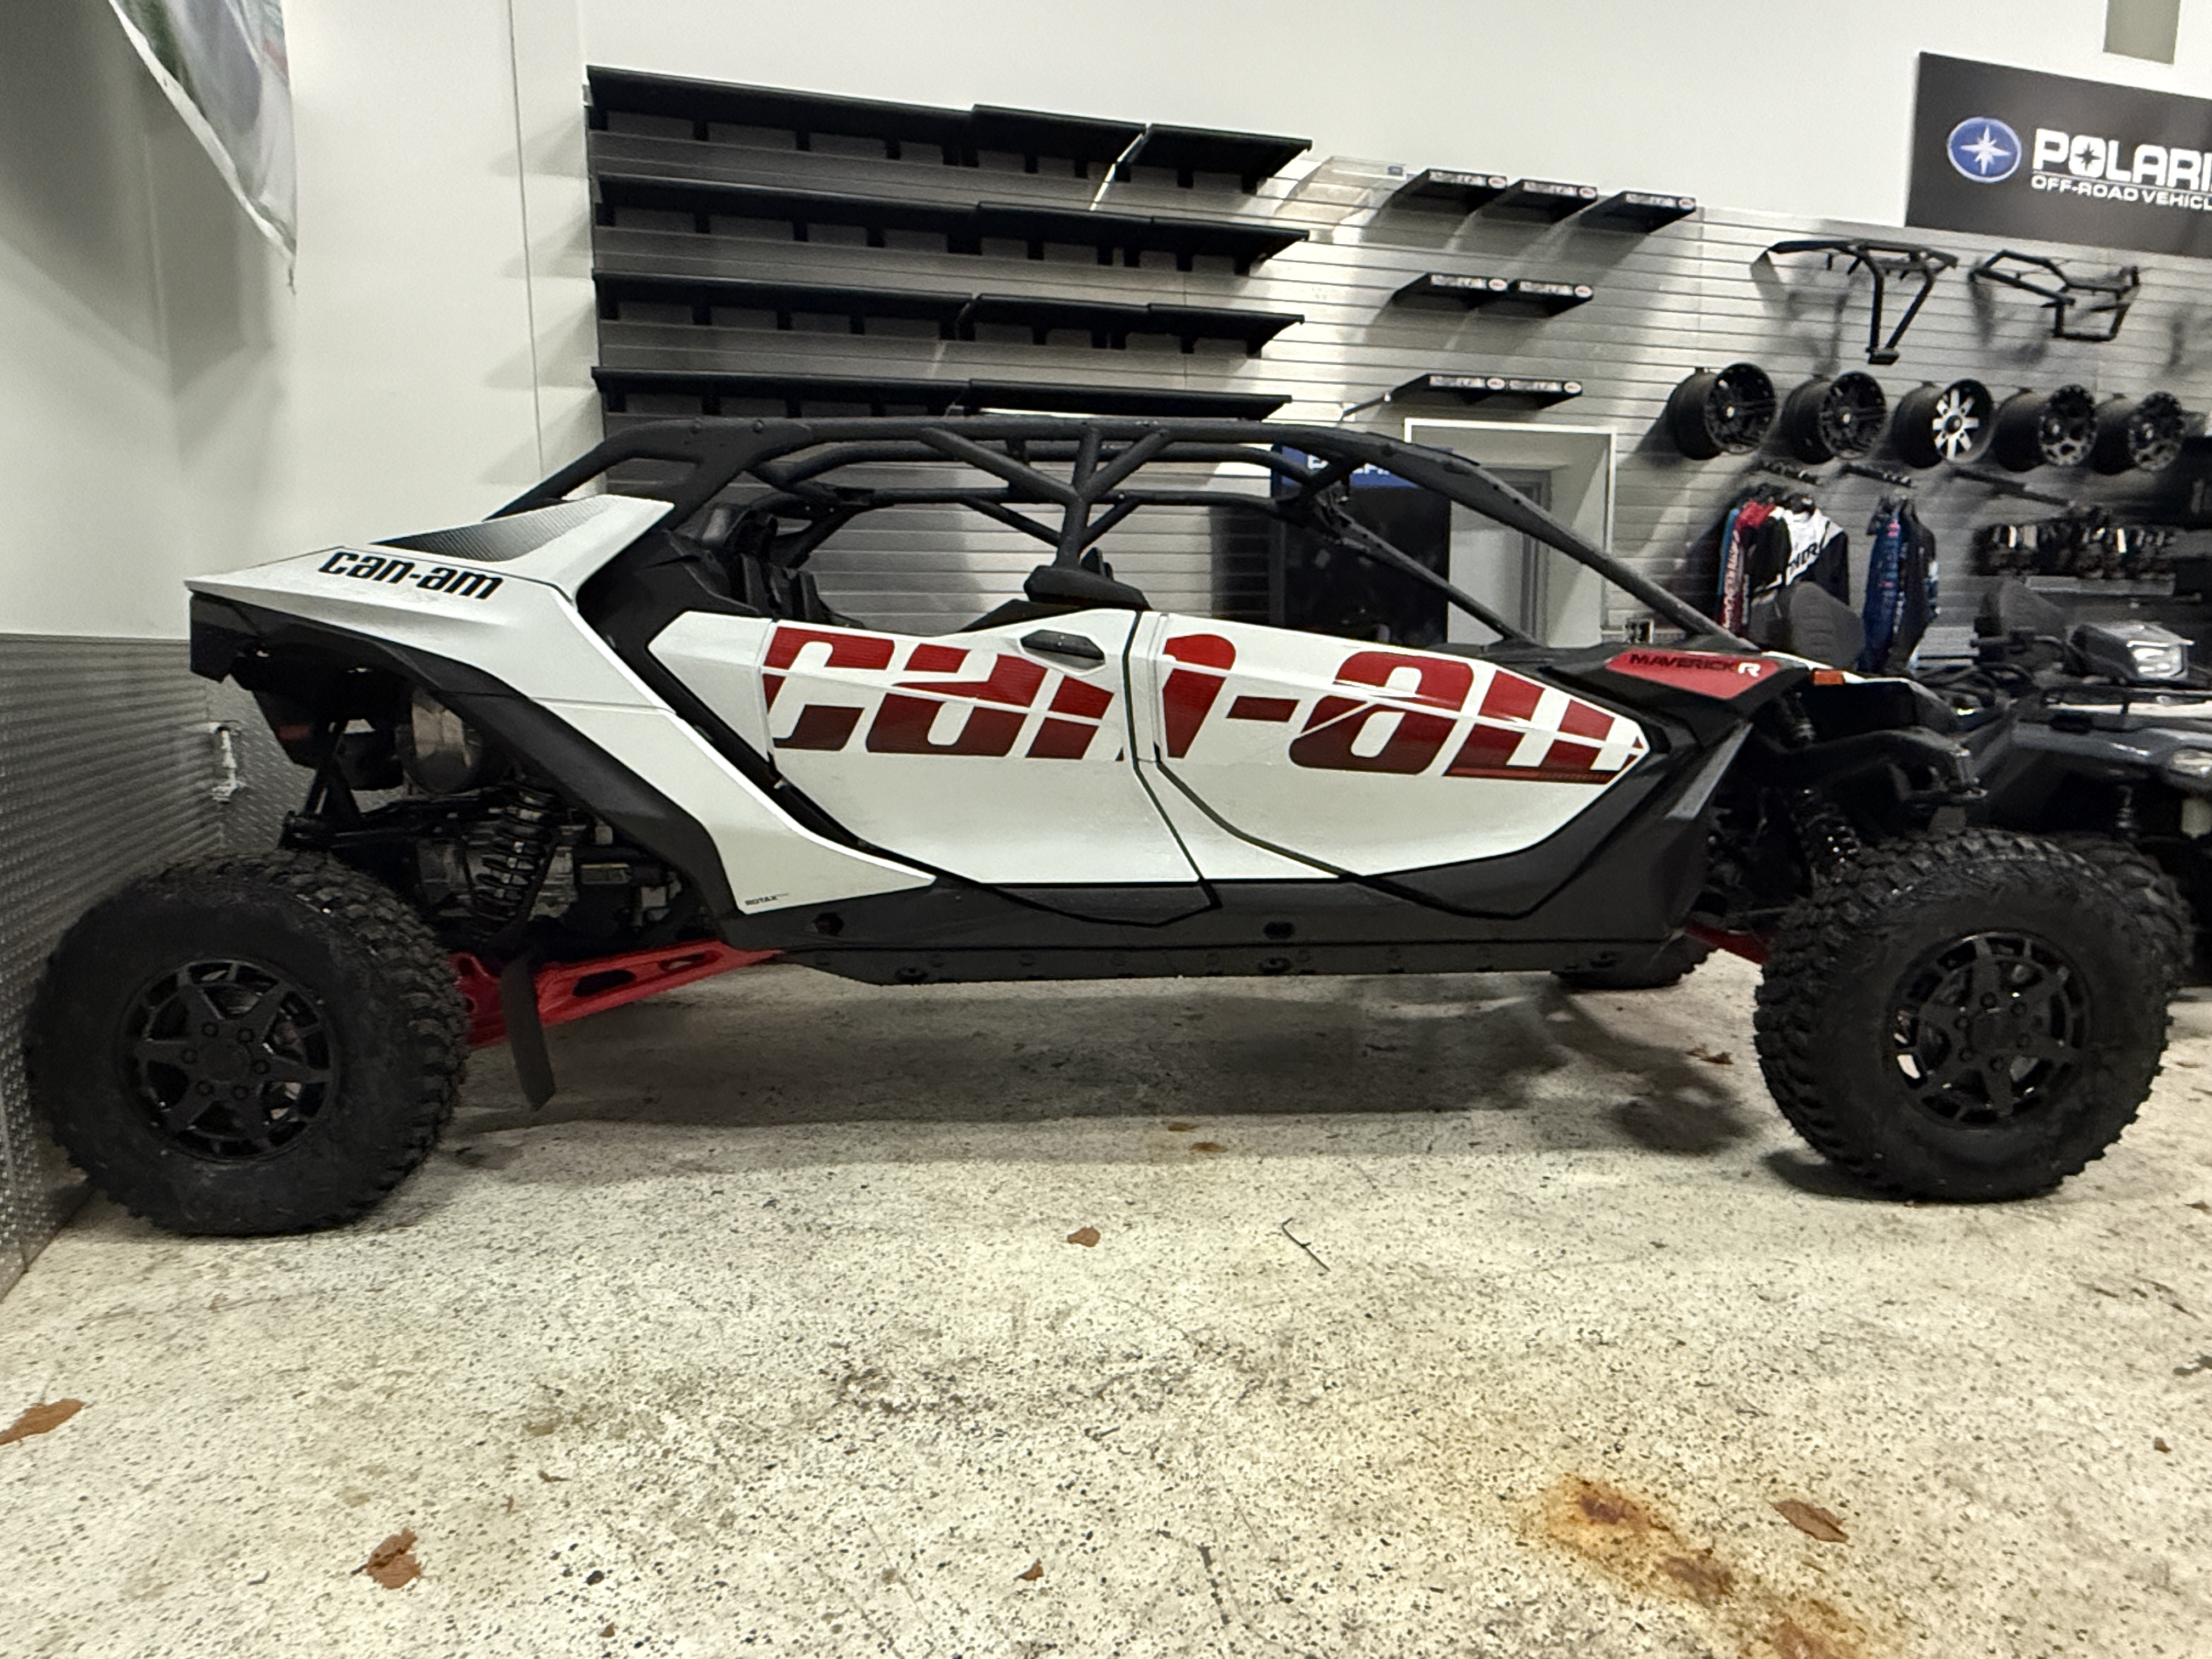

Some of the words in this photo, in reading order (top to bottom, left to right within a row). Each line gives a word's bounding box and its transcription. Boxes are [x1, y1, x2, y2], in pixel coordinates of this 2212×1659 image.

[2032, 128, 2212, 191] POLARI
[2031, 175, 2139, 202] OFF-ROAD
[318, 551, 503, 600] can-am
[1629, 653, 1735, 672] MAVERICK
[1737, 662, 1761, 678] R
